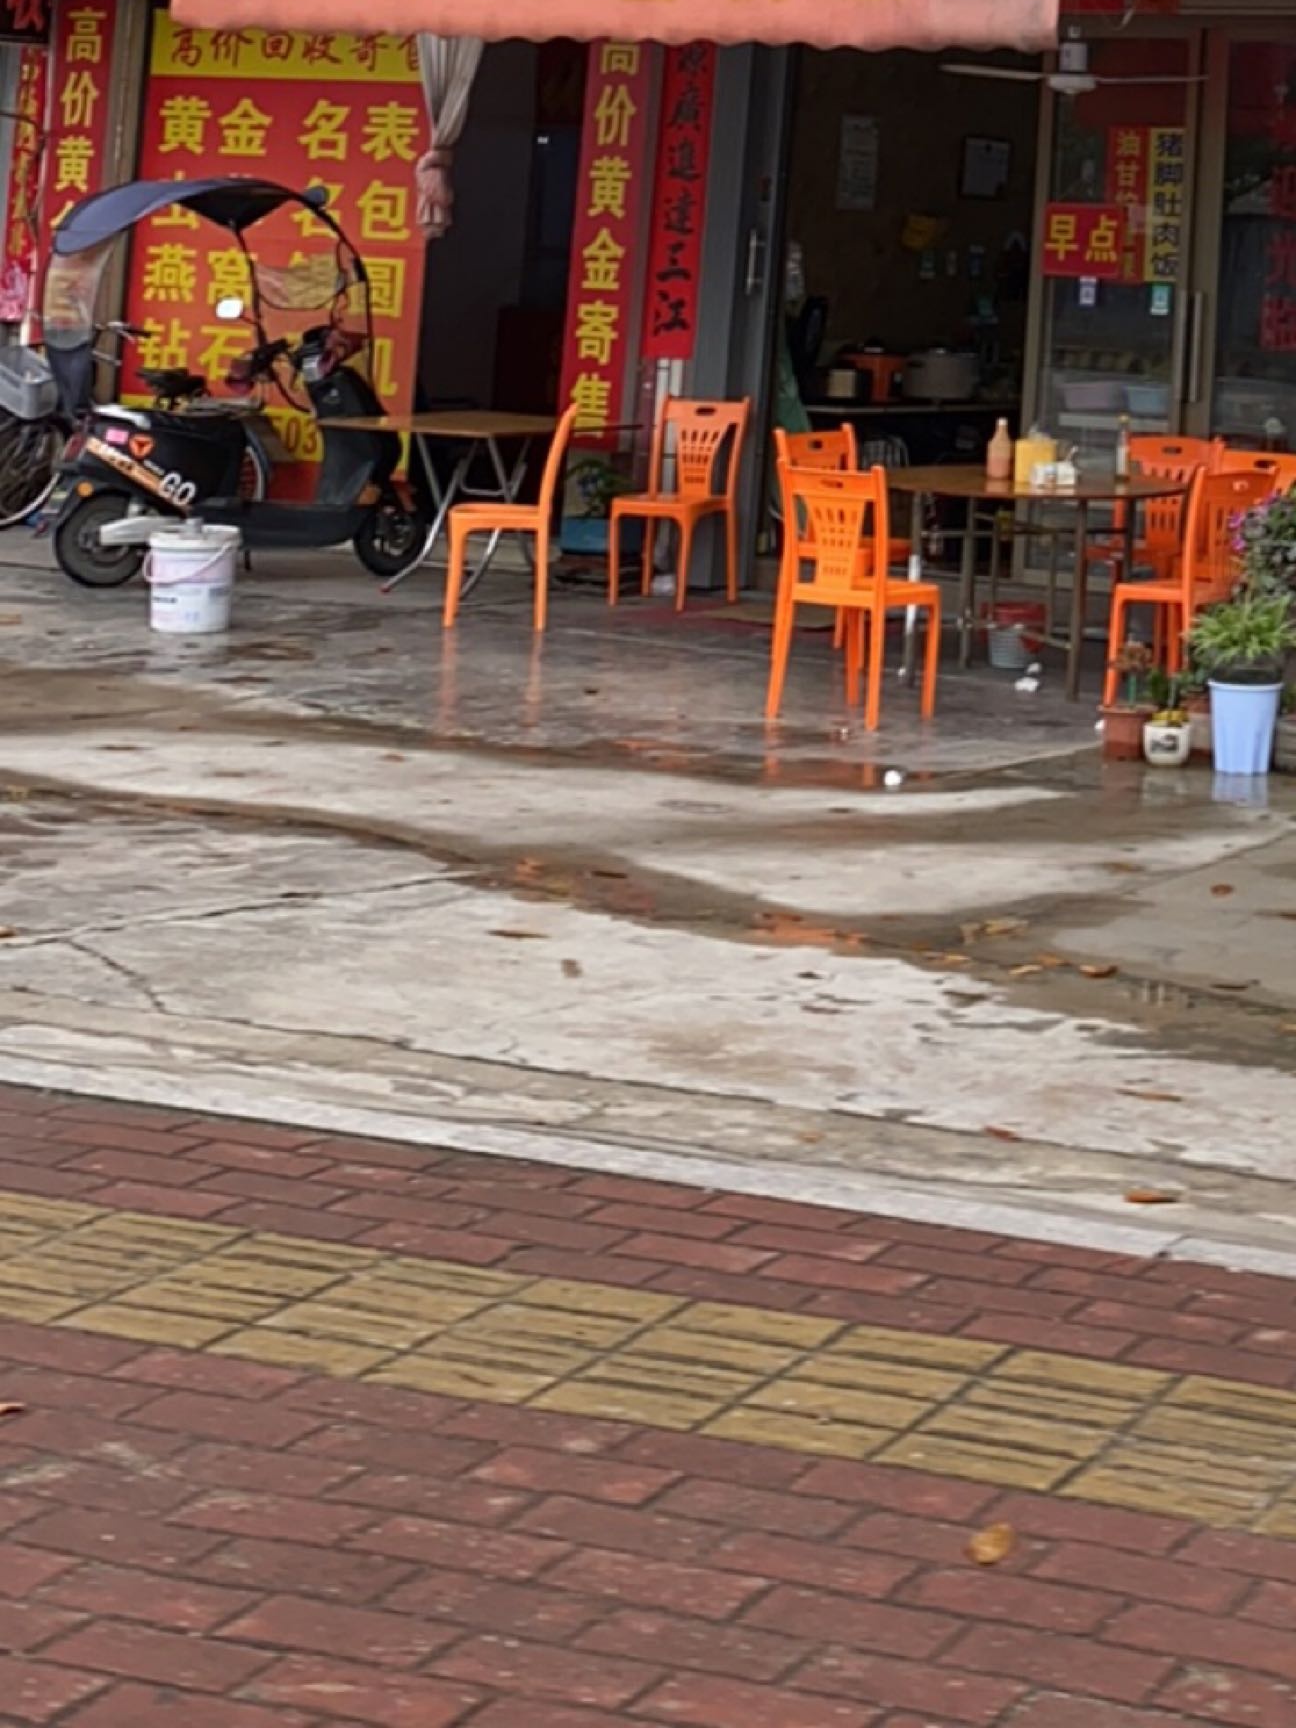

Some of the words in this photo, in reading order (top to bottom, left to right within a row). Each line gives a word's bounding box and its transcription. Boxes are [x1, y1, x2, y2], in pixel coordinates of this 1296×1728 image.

[50, 6, 108, 230] 高价黄
[157, 95, 273, 157] 黄金
[297, 99, 421, 162] 名表
[1044, 212, 1119, 263] 早点
